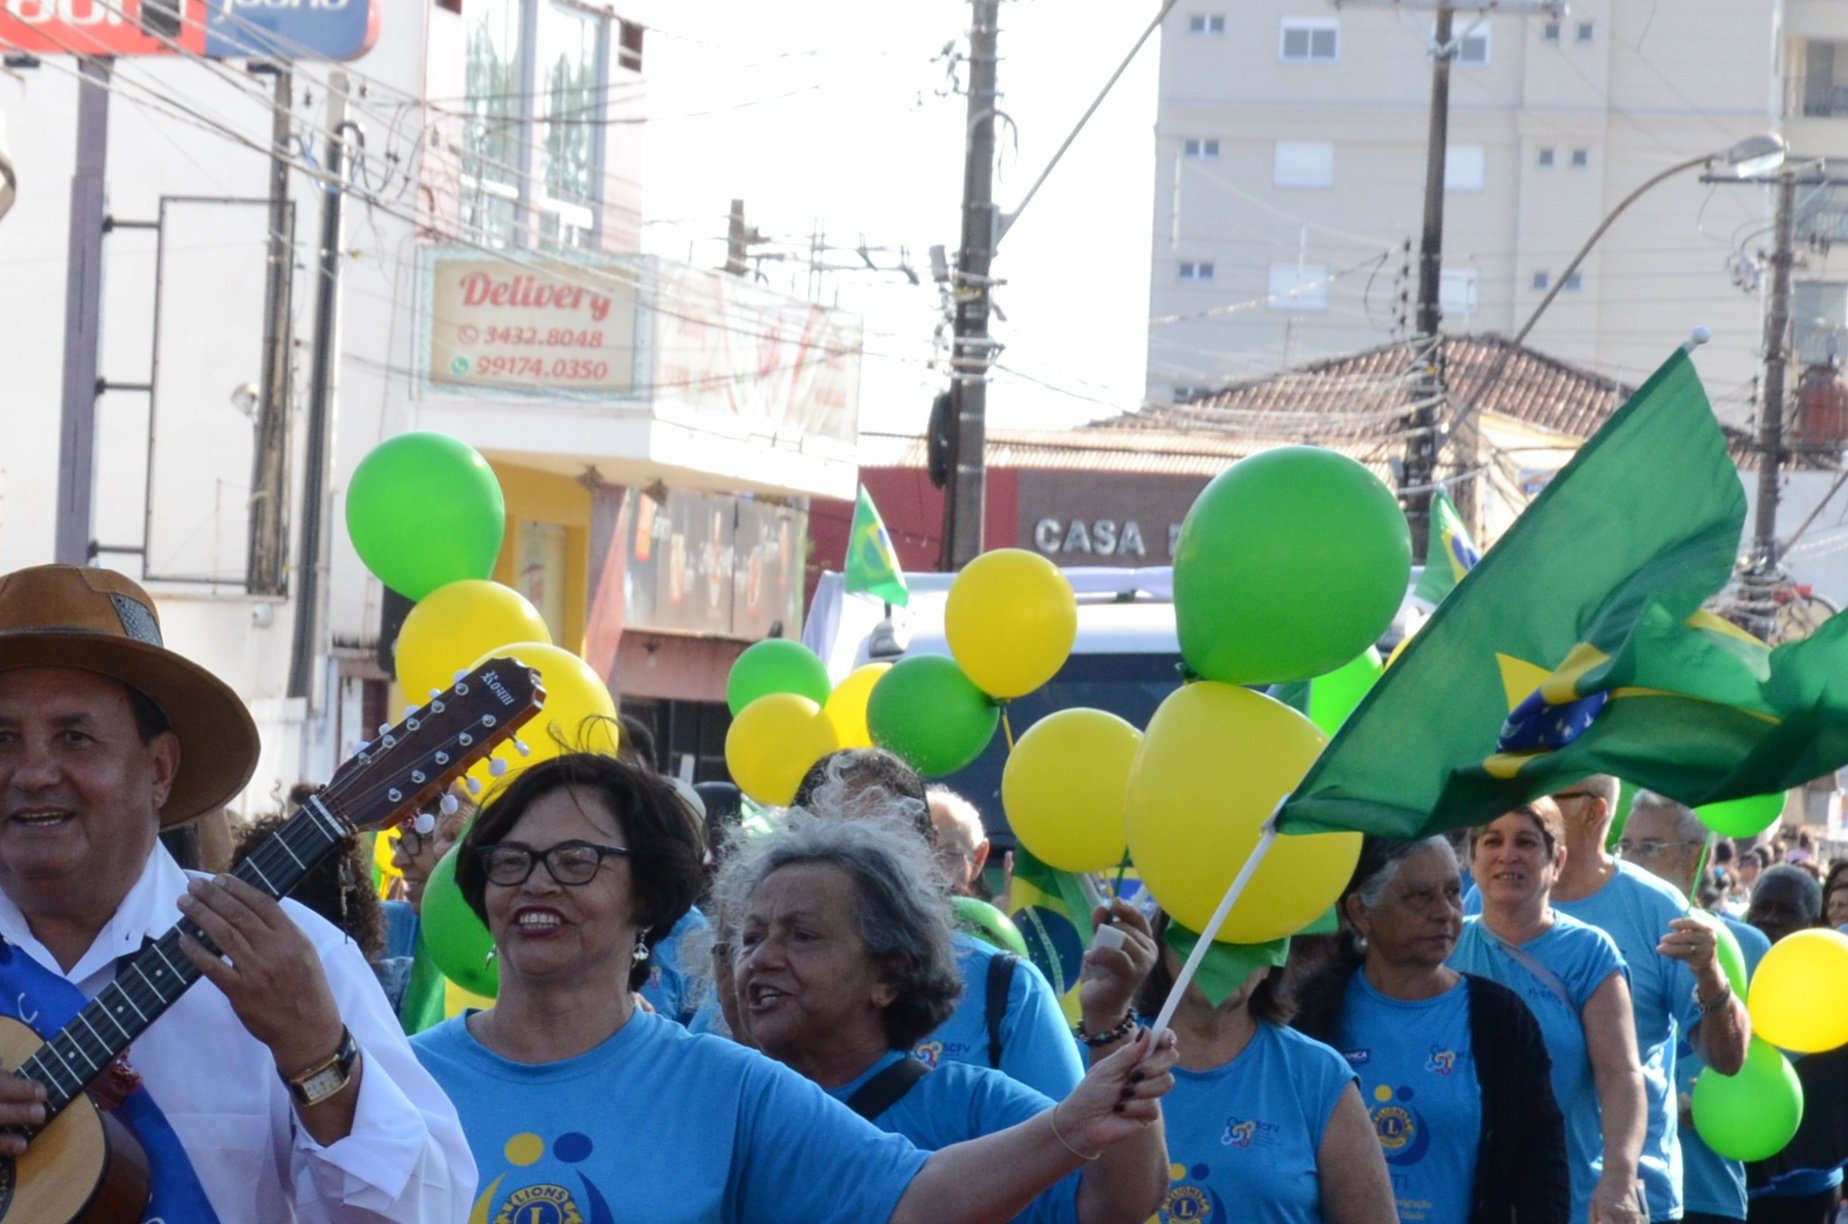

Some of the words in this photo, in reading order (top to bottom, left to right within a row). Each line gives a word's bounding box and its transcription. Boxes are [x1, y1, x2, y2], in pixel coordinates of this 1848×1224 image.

[459, 271, 613, 322] Delivery
[484, 325, 604, 348] 3432.8048
[476, 355, 609, 380] 99174.0350
[1035, 517, 1146, 556] CASA
[514, 1186, 566, 1203] LIONS
